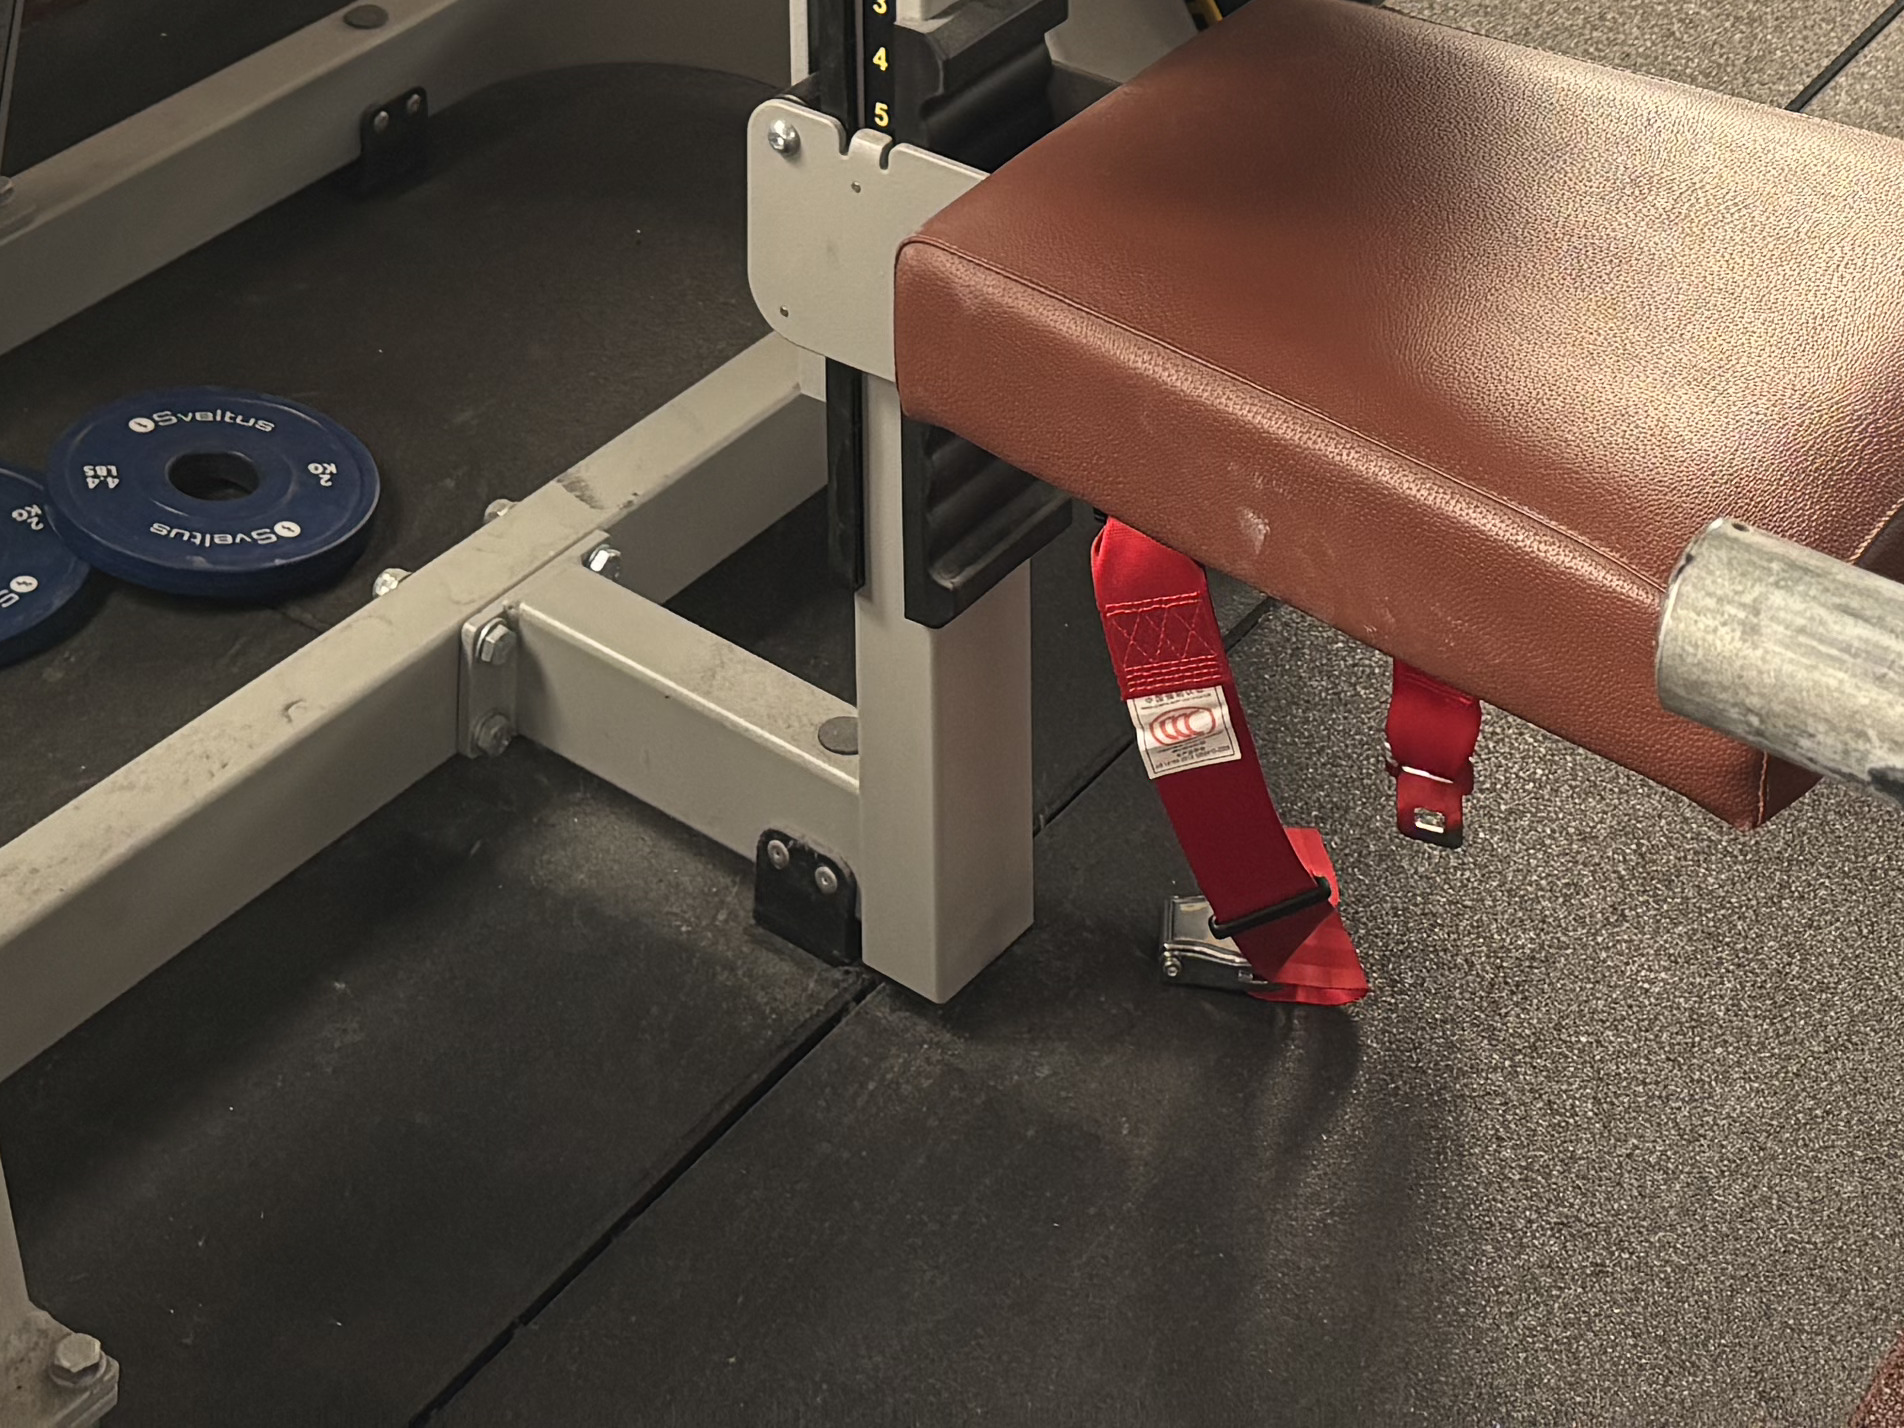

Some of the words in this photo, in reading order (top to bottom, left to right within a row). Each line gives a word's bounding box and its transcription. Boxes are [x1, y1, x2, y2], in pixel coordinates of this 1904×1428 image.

[872, 47, 888, 70] 4
[874, 102, 889, 127] 5
[152, 409, 276, 433] Sveltus
[318, 474, 333, 487] 2
[26, 516, 45, 531] 2
[149, 522, 278, 548] Sveltus
